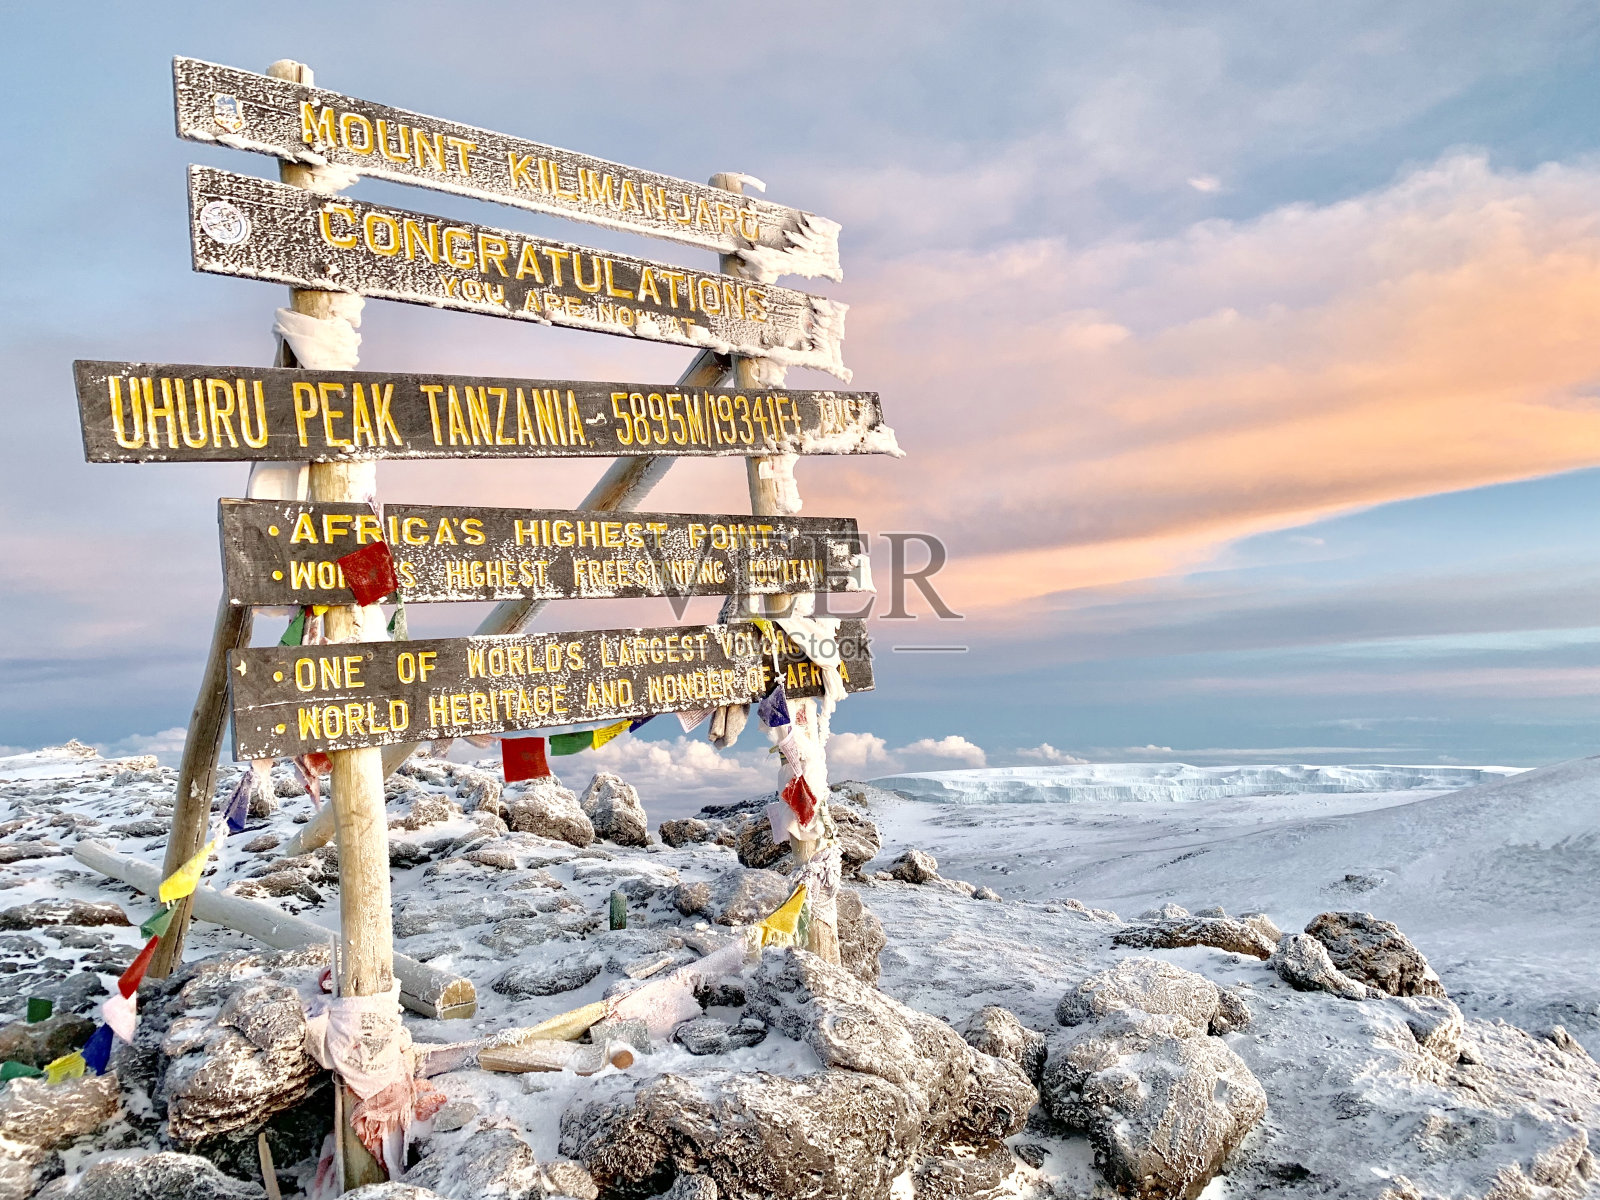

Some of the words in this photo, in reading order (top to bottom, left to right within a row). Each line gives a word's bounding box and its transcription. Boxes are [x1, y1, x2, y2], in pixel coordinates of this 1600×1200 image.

[300, 102, 477, 177] MOUNT
[506, 151, 760, 242] KILIMANJARO
[317, 202, 769, 324] CONGRATULATIONS
[438, 273, 505, 304] YOU
[107, 375, 268, 450] UHURU
[291, 381, 404, 448] PEAK
[289, 512, 487, 547] AFRICA'S
[513, 518, 669, 548] HIGHEST
[445, 559, 550, 589] HIGHEST
[294, 655, 366, 692] ONE
[397, 650, 438, 685] OF
[600, 634, 709, 669] LARGEST
[297, 699, 410, 741] WORLD
[428, 683, 569, 728] HERITAGE
[585, 677, 634, 711] AND
[647, 668, 735, 704] WONDER
[746, 664, 771, 694] OF
